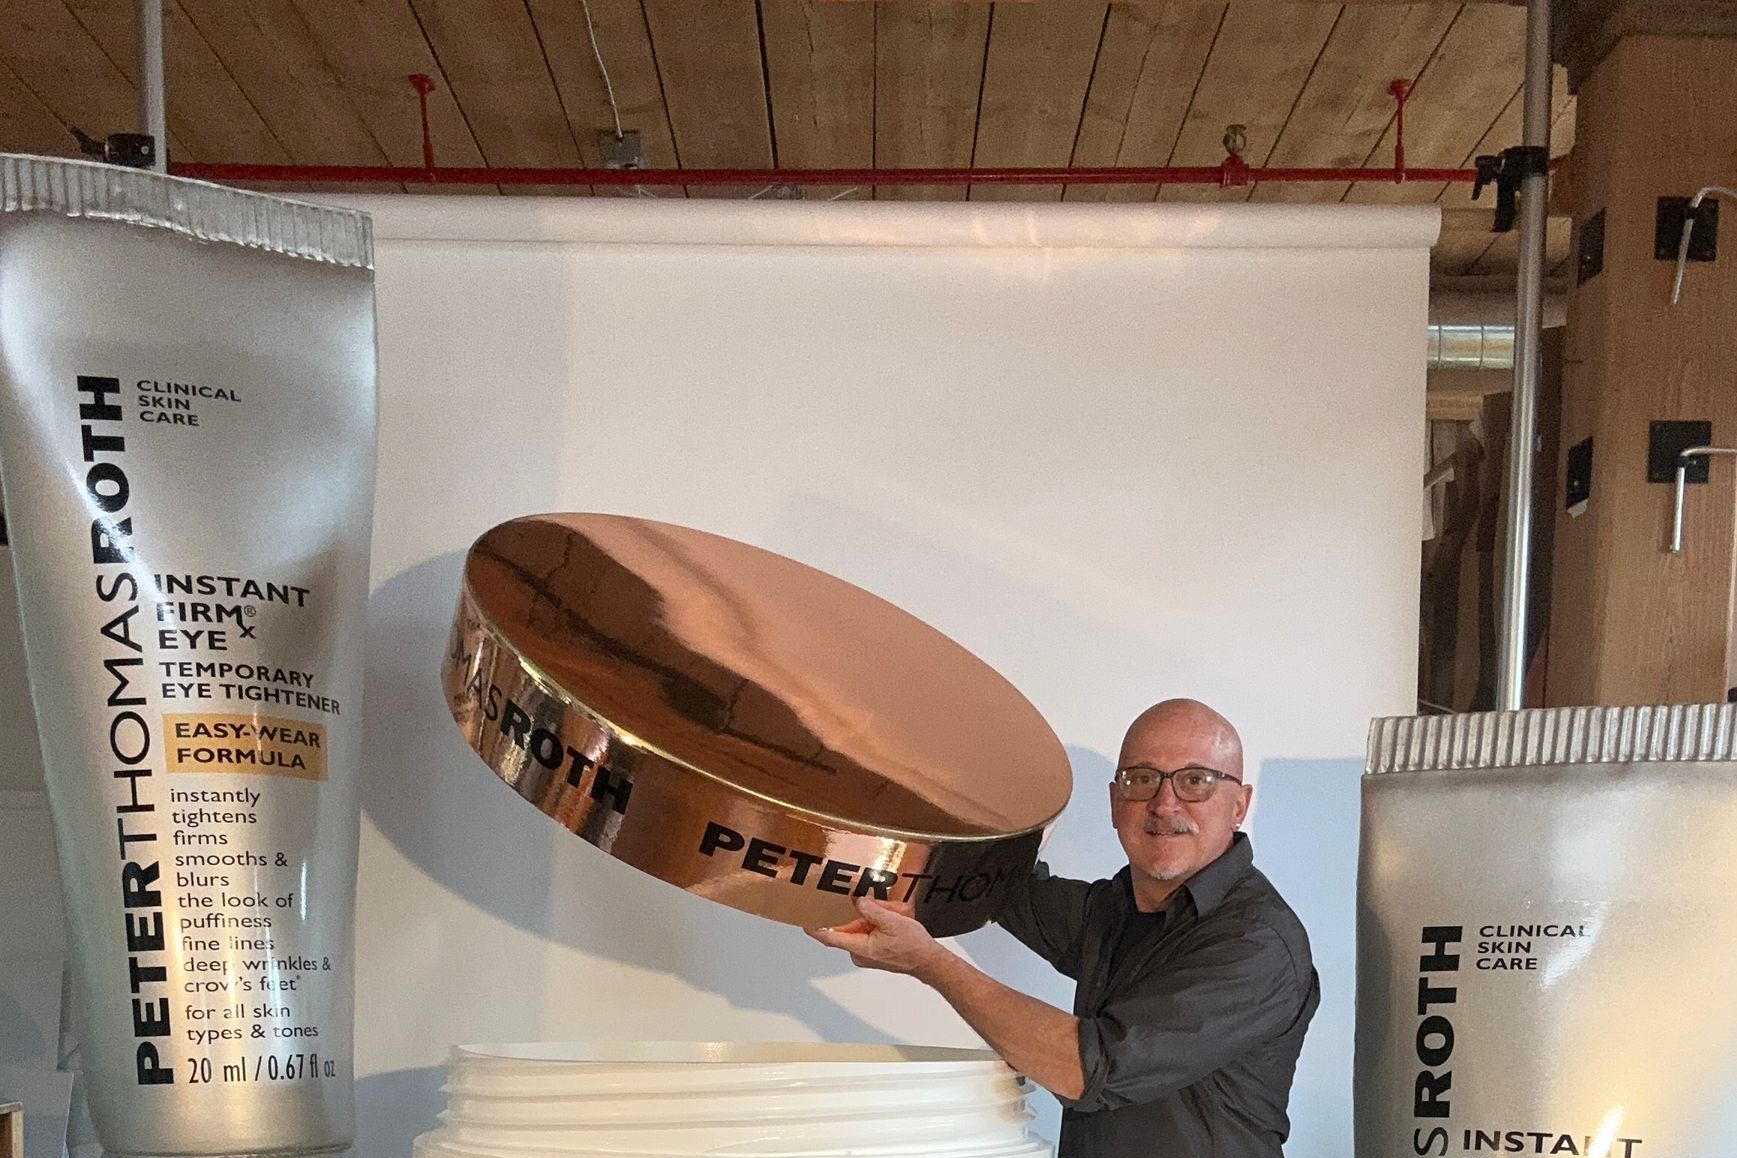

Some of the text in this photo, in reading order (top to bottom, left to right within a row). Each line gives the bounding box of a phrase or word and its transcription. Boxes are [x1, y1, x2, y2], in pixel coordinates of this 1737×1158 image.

[136, 379, 242, 402] CLINICAL
[138, 394, 191, 410] SKIN
[139, 410, 200, 426] CARE
[154, 573, 310, 607] INSTANT
[158, 628, 228, 651] EYE
[159, 661, 314, 688] TEMPORARY
[162, 683, 341, 715] EYE TIGHTENER
[175, 721, 322, 748] EASY-WEAR
[176, 746, 306, 770] FORMULA
[169, 787, 261, 808] instantly
[172, 808, 258, 828] tightens
[173, 829, 229, 847] firms
[174, 850, 289, 868] smooths &
[176, 872, 230, 888] blurs
[177, 892, 295, 909] the look of
[180, 914, 273, 935] puffiness
[1479, 924, 1590, 938] CLINICAL
[182, 935, 275, 952] fine lines
[1477, 941, 1532, 954] SKIN
[242, 956, 318, 972] wrinkles
[321, 957, 332, 972] &
[1475, 957, 1538, 971] CARE
[185, 1003, 291, 1020] for all skin
[187, 1024, 319, 1046] types & tones
[188, 1058, 213, 1084] 20
[223, 1056, 247, 1082] ml
[268, 1054, 304, 1081] 0.67
[310, 1053, 319, 1078] fl
[324, 1061, 336, 1078] oz
